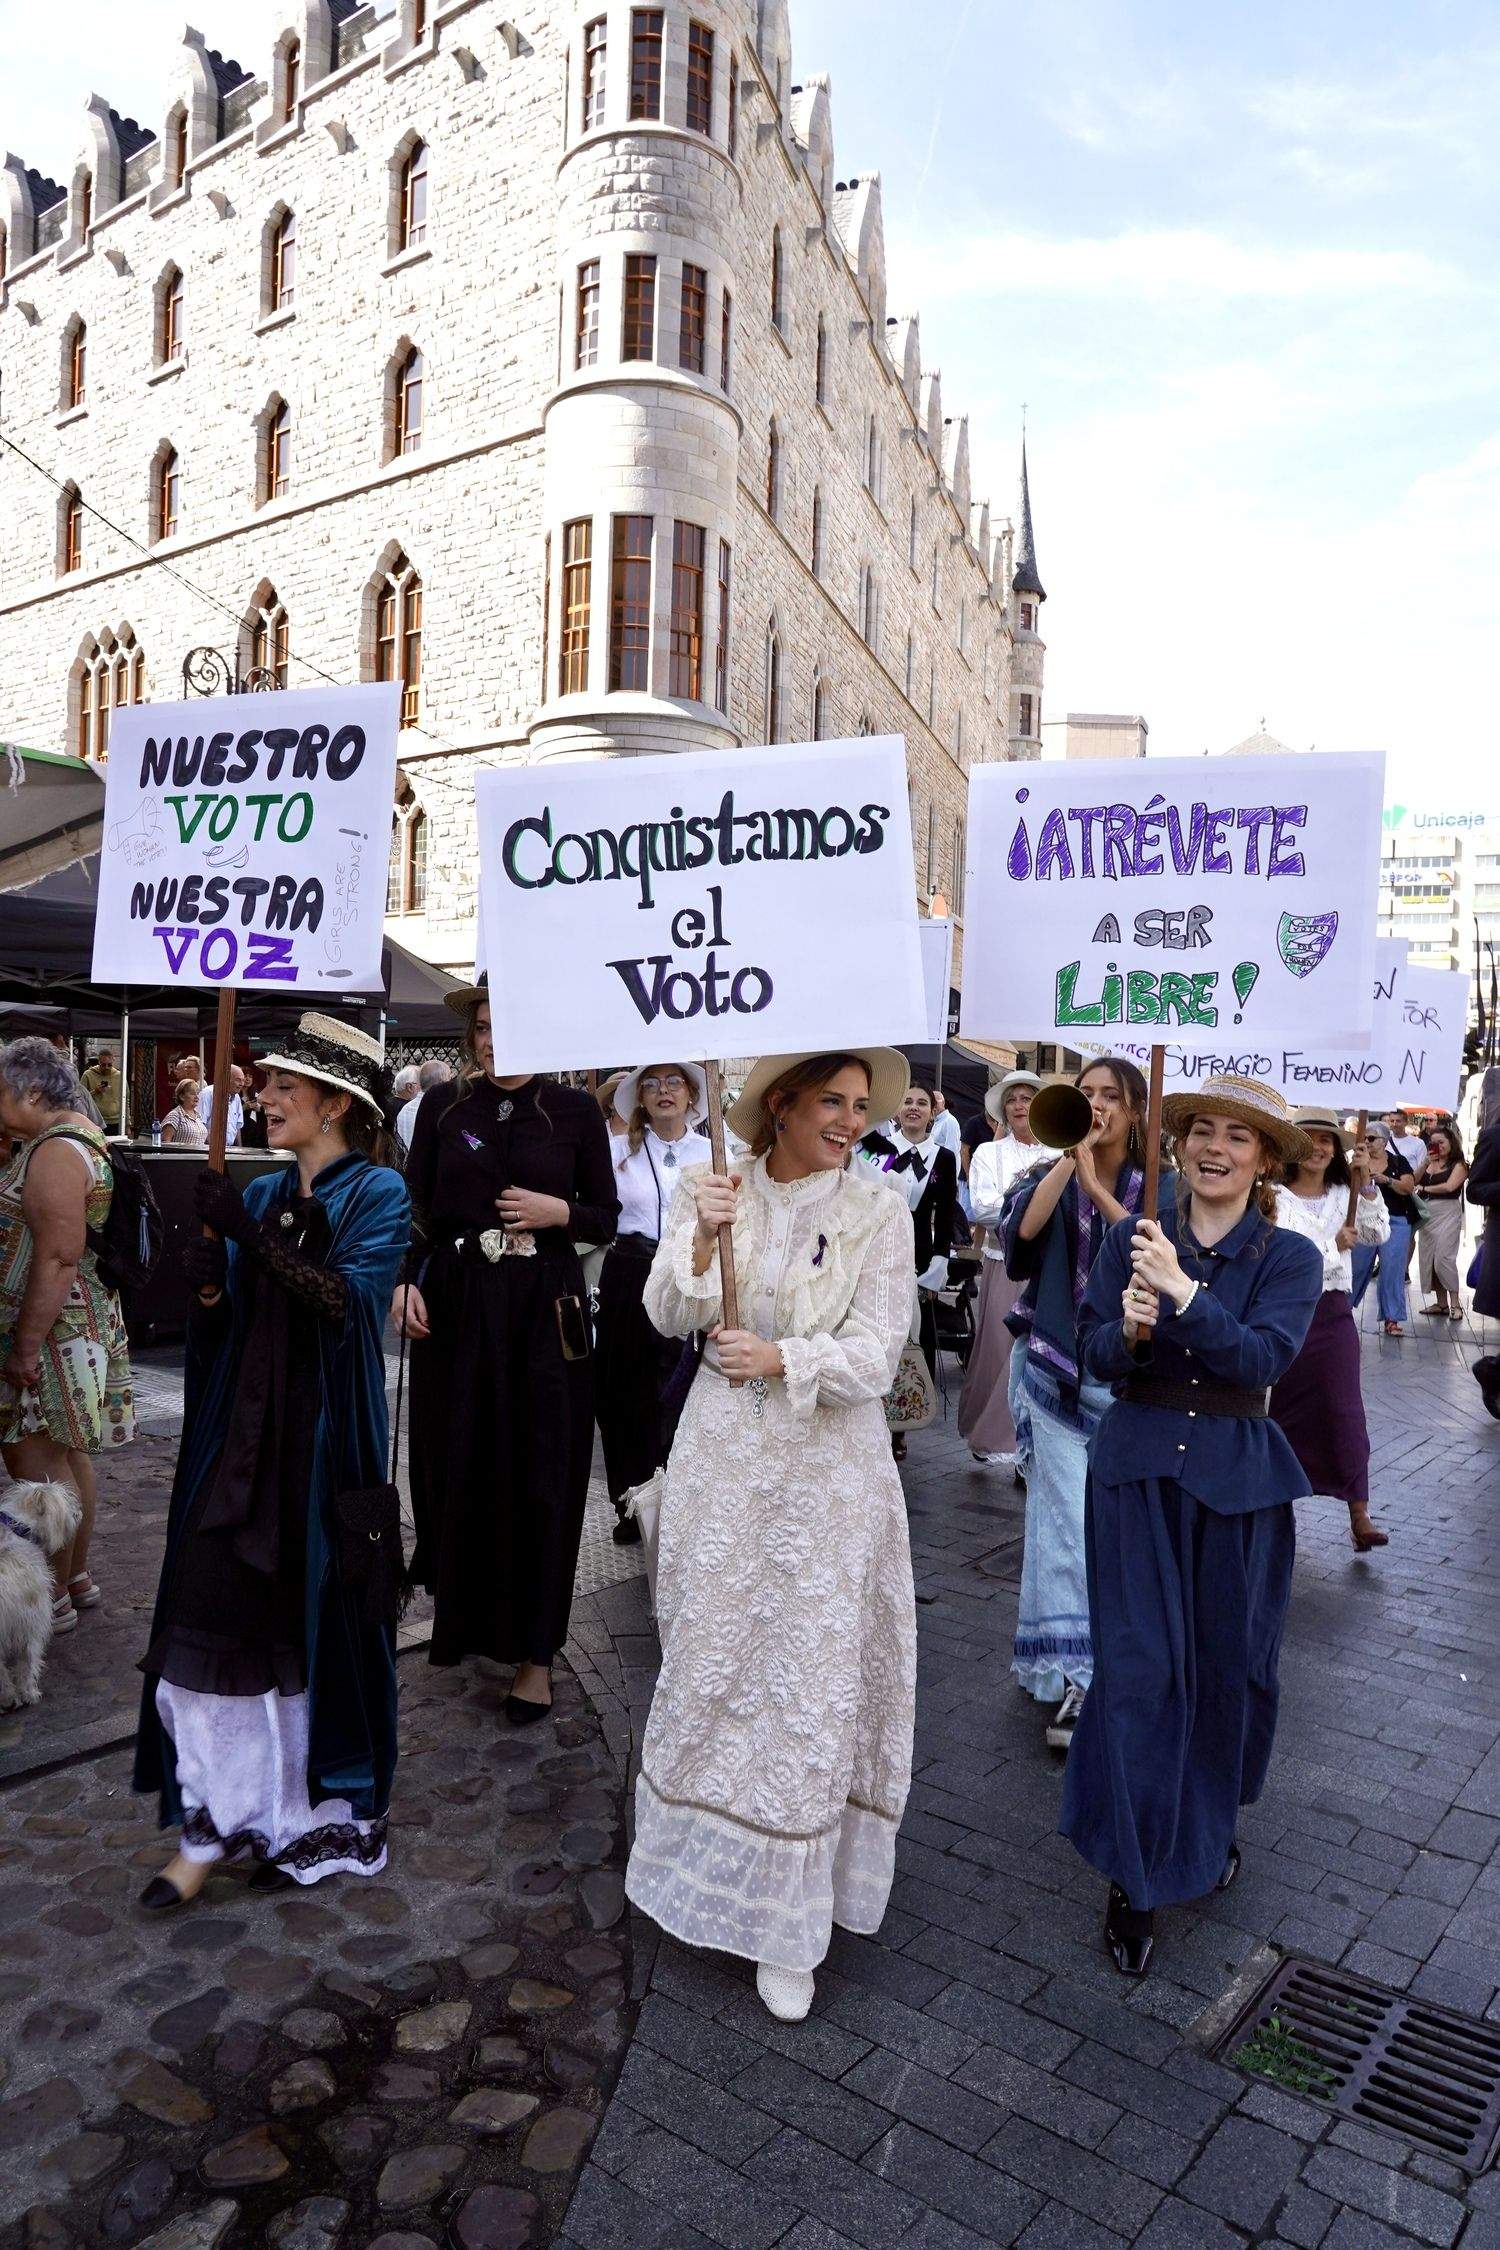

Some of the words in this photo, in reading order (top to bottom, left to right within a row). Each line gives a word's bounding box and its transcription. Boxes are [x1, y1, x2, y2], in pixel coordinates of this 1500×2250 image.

[140, 724, 366, 788] NUESTRO
[164, 792, 314, 844] VOTO
[1007, 788, 1309, 881] ¡ATRÉVETE
[1414, 812, 1485, 830] Unicaja
[335, 863, 345, 895] ARE
[502, 790, 891, 909] Conquistamos
[130, 874, 325, 934] NUESTRA
[671, 885, 731, 948] el
[1092, 912, 1120, 943] A
[1134, 905, 1213, 950] SER
[153, 927, 298, 981] VOZ
[605, 951, 774, 1026] Voto
